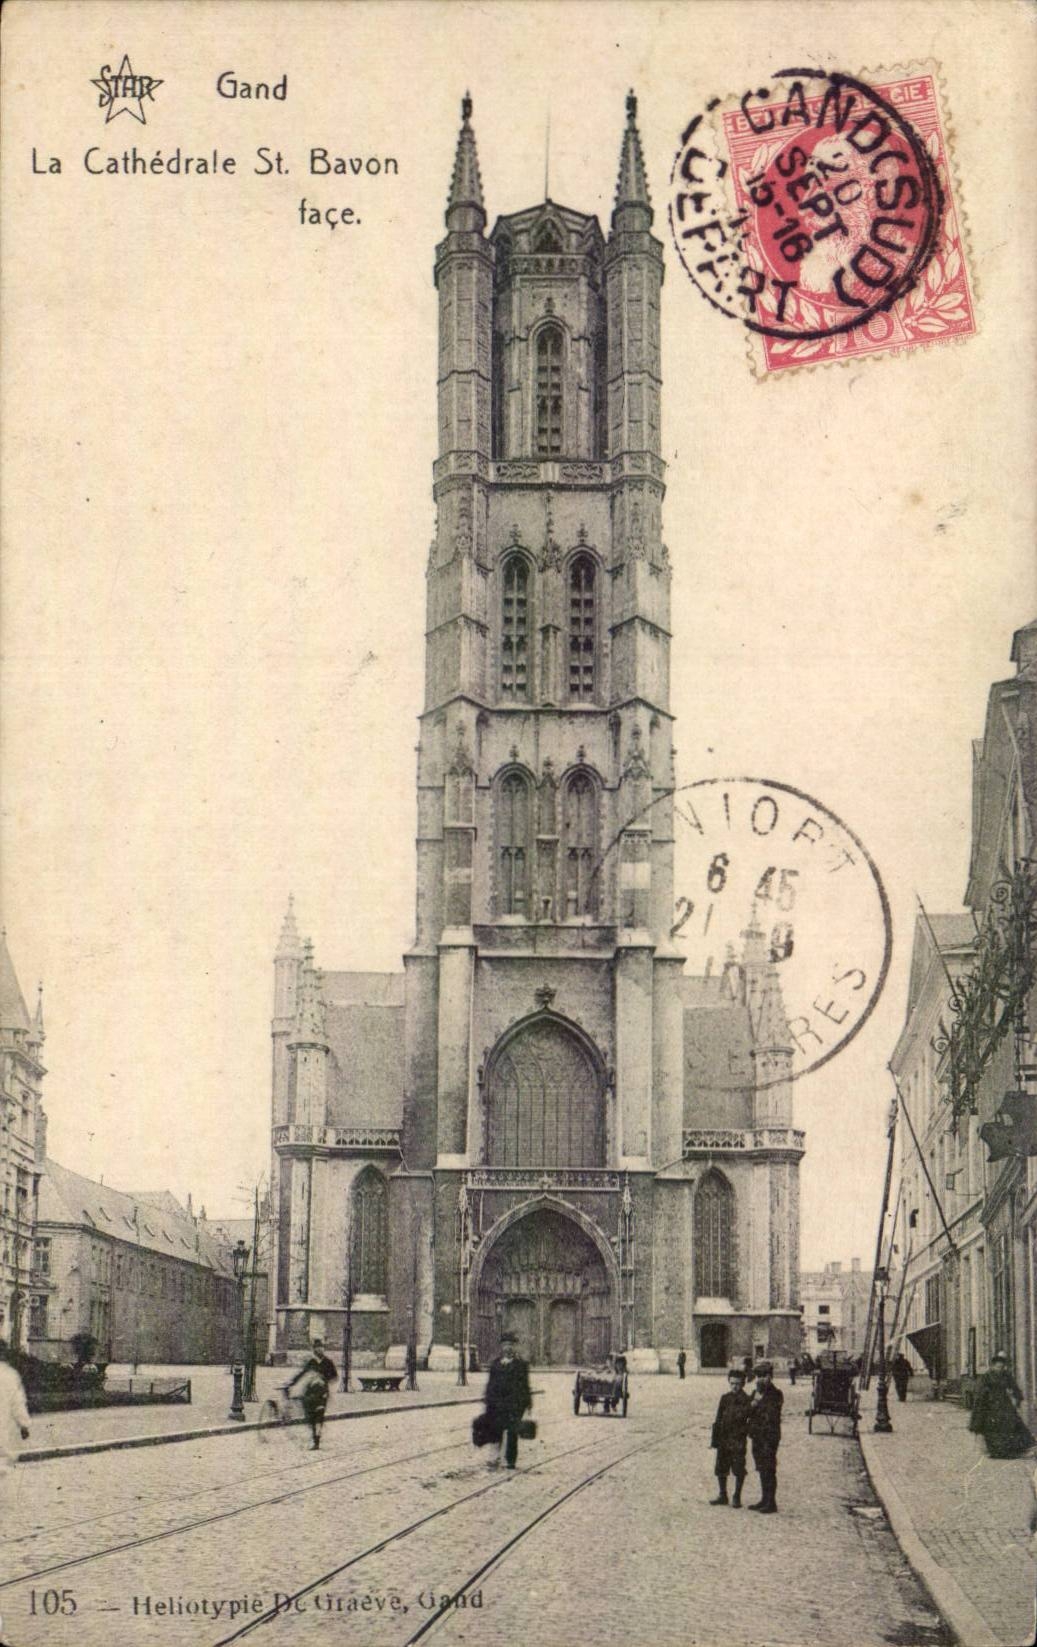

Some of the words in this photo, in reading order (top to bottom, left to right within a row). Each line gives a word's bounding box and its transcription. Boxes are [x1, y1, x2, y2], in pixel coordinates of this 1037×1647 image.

[736, 98, 835, 133] BELGUE
[774, 146, 849, 242] SEPT
[816, 152, 862, 206] 20
[842, 311, 895, 348] 10
[707, 852, 731, 894] 6
[754, 866, 800, 912] 45
